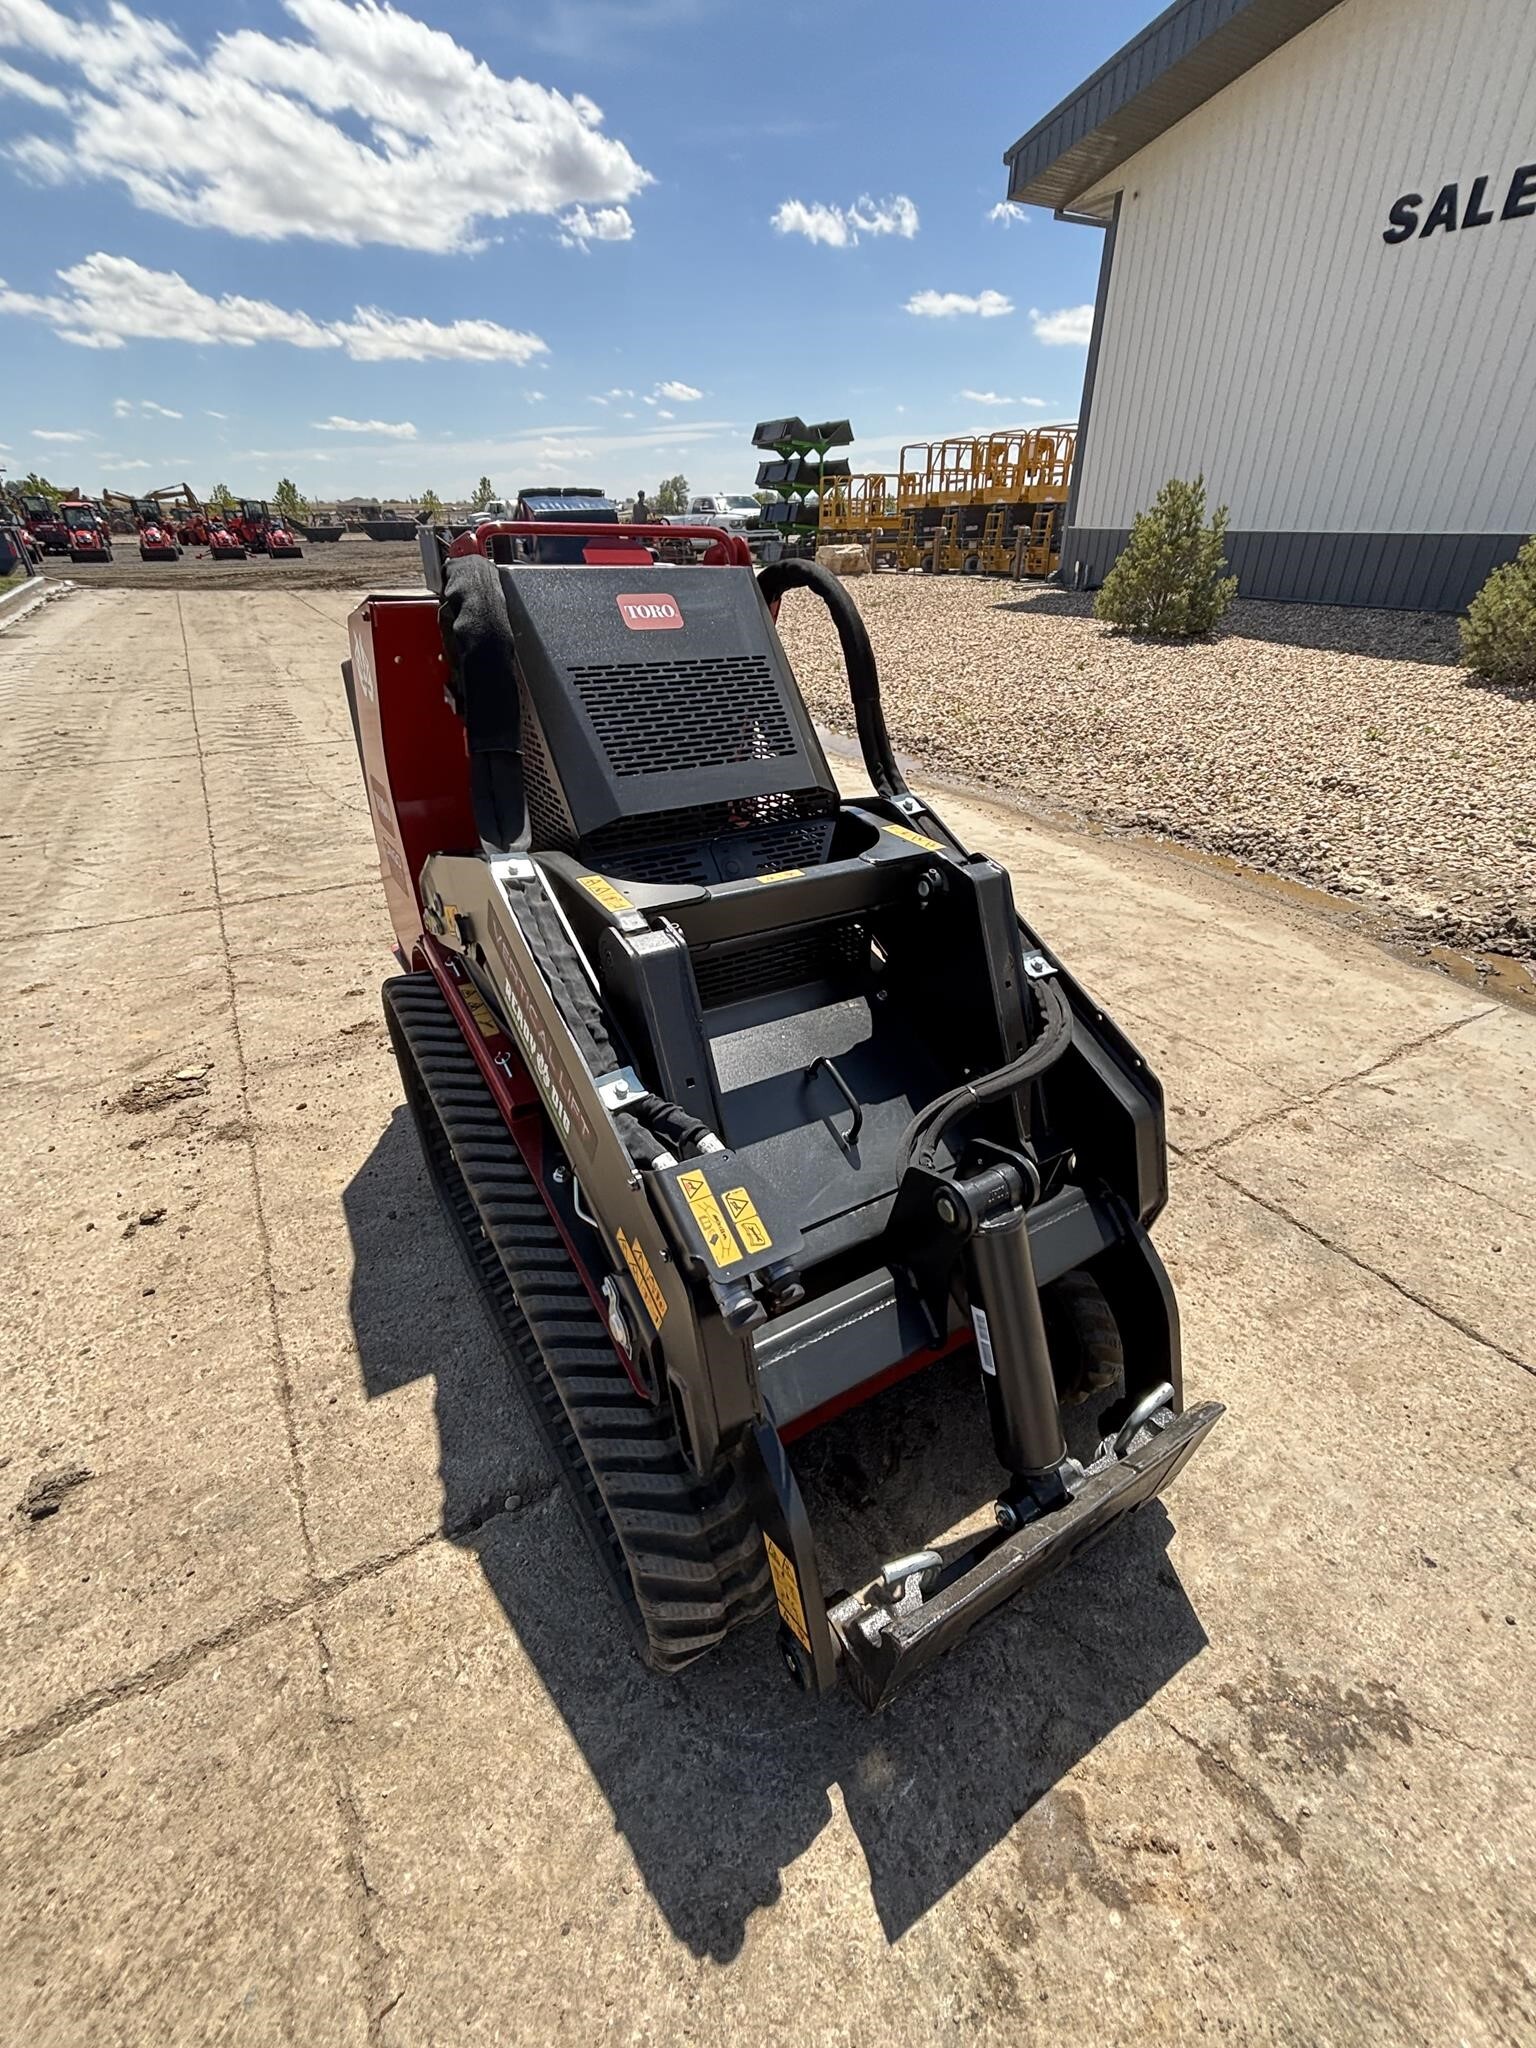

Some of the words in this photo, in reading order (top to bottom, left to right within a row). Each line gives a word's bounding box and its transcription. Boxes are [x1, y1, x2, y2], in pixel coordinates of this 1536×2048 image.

[1383, 163, 1536, 244] SALE
[623, 604, 675, 619] TORO
[492, 918, 556, 1072] VERTICAL
[559, 1070, 590, 1134] LIFT
[505, 977, 537, 1054] READY
